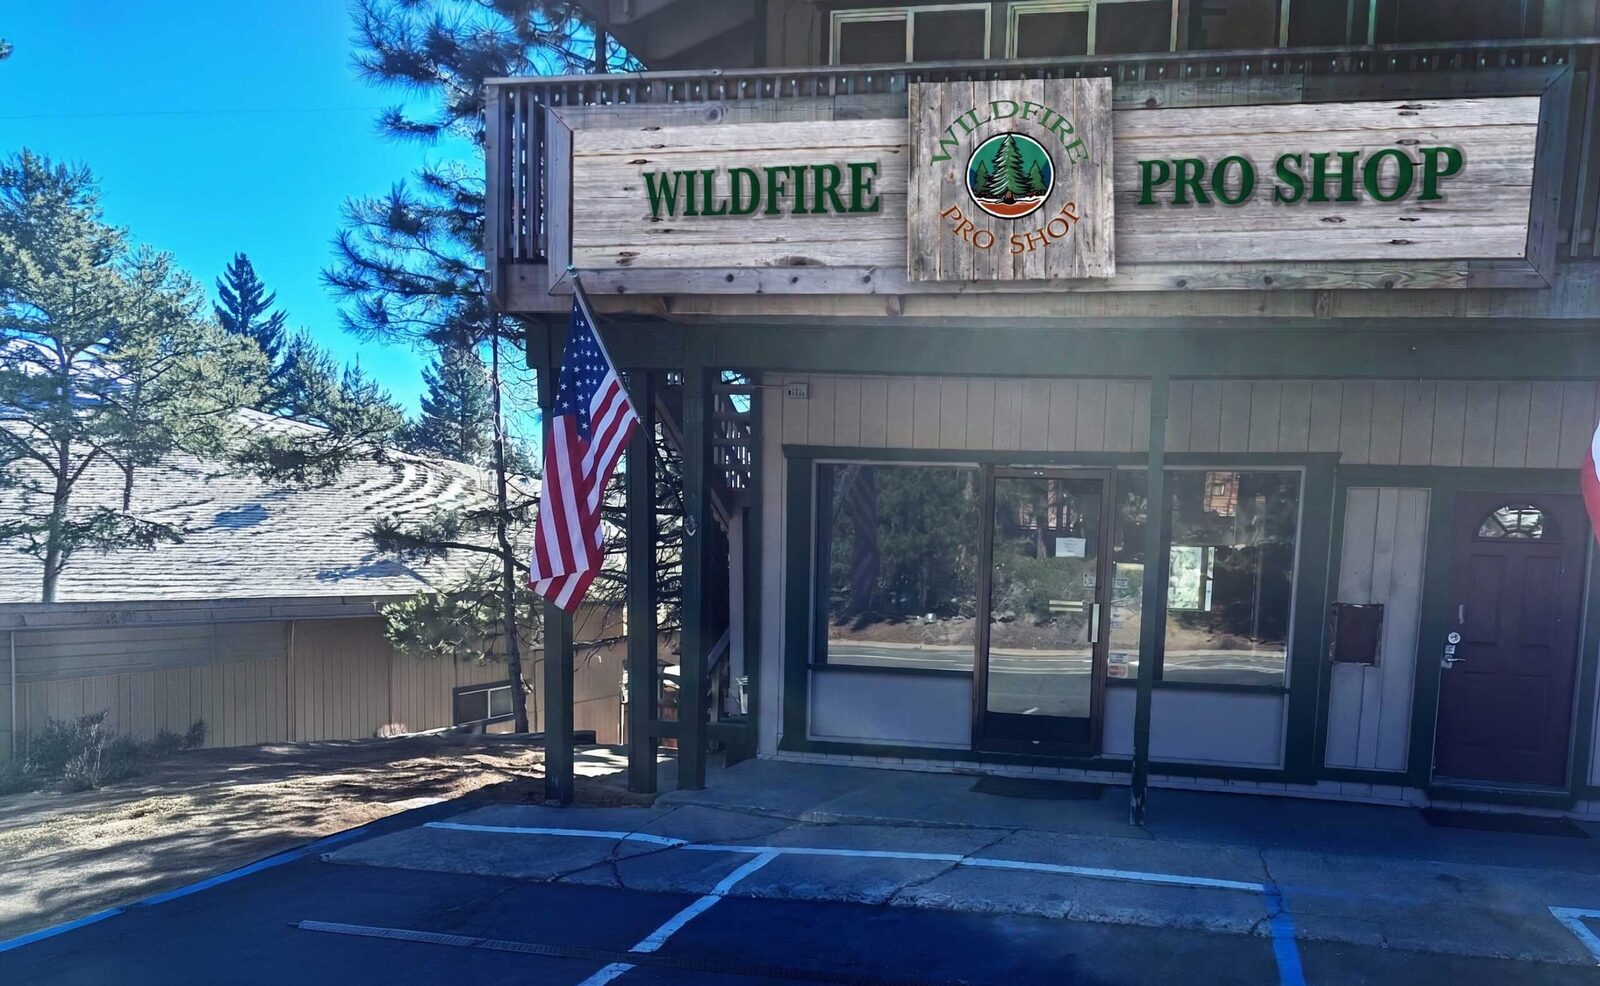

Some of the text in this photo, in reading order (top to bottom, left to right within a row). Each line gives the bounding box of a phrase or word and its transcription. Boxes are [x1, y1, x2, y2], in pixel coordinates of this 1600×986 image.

[930, 100, 1090, 166] WILDFIRE
[642, 161, 880, 217] WILDFIRE
[1137, 146, 1464, 206] PRO SHOP
[939, 201, 1081, 254] PRO SHOP
